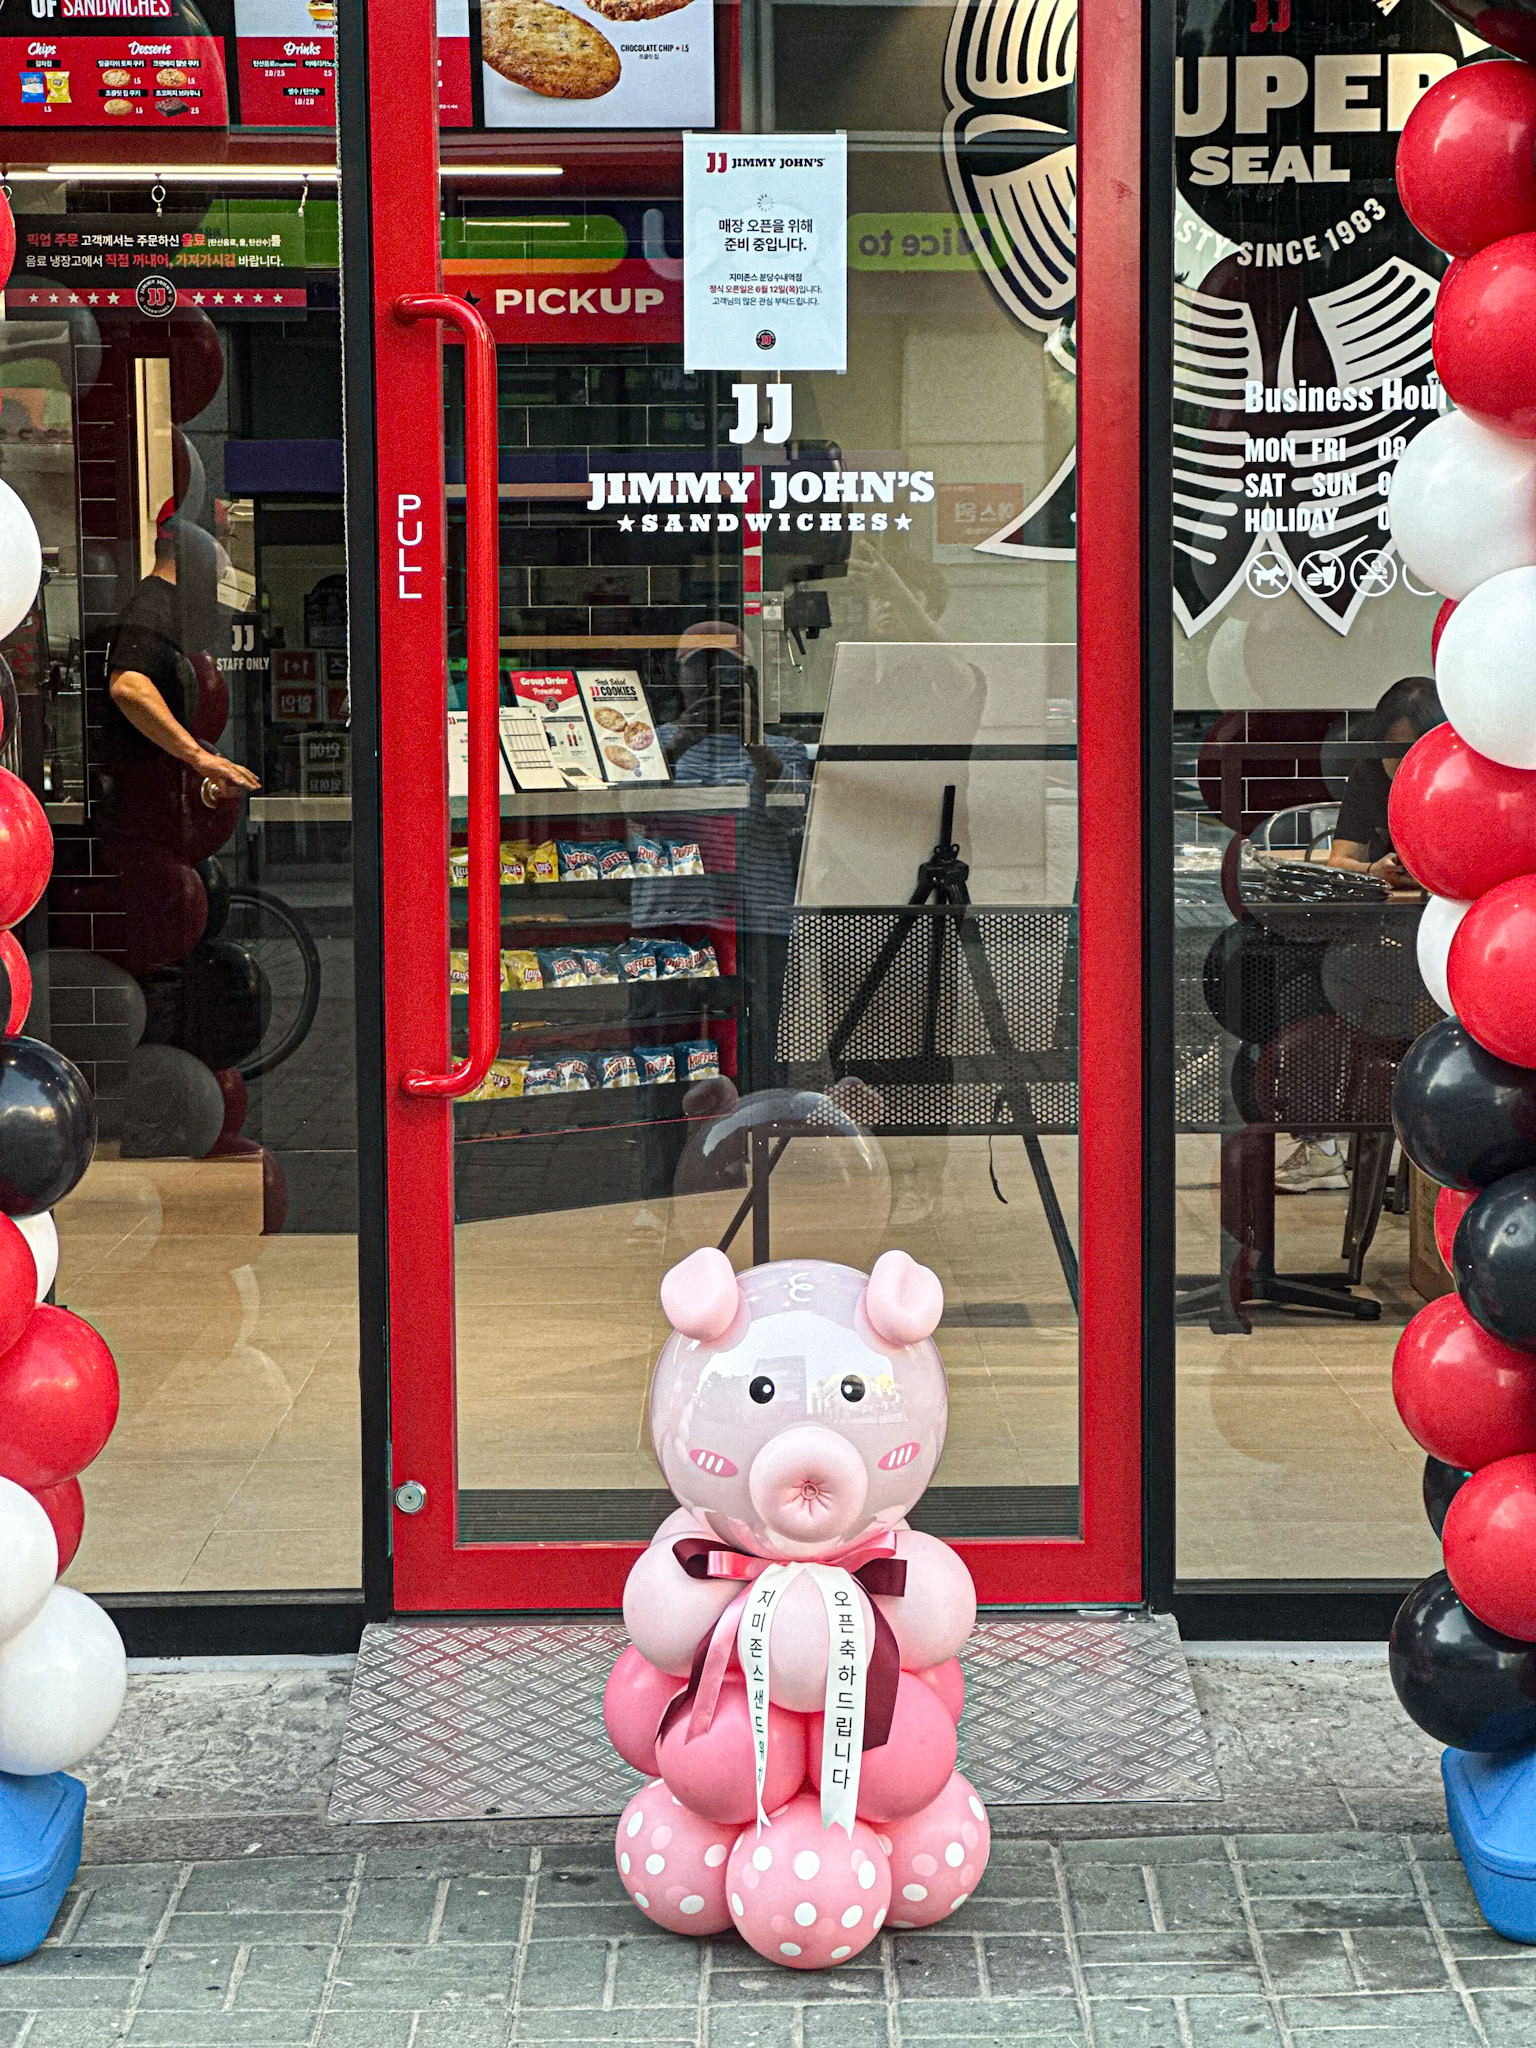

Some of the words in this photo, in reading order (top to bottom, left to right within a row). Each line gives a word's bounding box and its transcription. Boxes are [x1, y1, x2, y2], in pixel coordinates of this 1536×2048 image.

[28, 42, 57, 58] Chips
[128, 41, 172, 55] Desserts
[283, 41, 321, 56] Drinks
[621, 44, 657, 52] CHOCOLATE
[658, 44, 674, 52] CHIP
[706, 152, 727, 173] JJ
[732, 158, 776, 169] JIMMY
[779, 158, 824, 169] JOHN'S
[1189, 145, 1350, 185] SEAL
[719, 218, 745, 233] 매장
[747, 218, 785, 233] 오픈을
[788, 218, 813, 233] 위해
[1175, 211, 1231, 260] STY
[1236, 235, 1321, 267] SINCE
[1324, 198, 1386, 251] 1983
[81, 235, 134, 247] 고객께서는
[136, 235, 179, 247] 주문하신
[182, 233, 205, 248] 음료
[725, 237, 749, 252] 준비
[752, 237, 807, 252] 중입니다.
[25, 255, 47, 267] 음료
[50, 255, 103, 267] 냉장고에서
[105, 253, 129, 267] 직접
[175, 253, 236, 268] 가져가시길
[238, 254, 284, 268] 바랍니다.
[495, 288, 665, 315] PICKUP
[1244, 379, 1374, 413] Business
[729, 383, 792, 444] JJ
[1245, 437, 1296, 462] MON
[1312, 437, 1346, 461] FRI
[586, 472, 755, 510] JIMMY
[769, 470, 935, 510] JOHN'S
[1245, 473, 1286, 497] SAT
[1312, 472, 1357, 496] SUN
[641, 513, 888, 532] SANDWICHES
[1245, 507, 1339, 532] HOLIDAY
[397, 493, 422, 599] PULL
[231, 624, 255, 652] JJ
[216, 657, 244, 671] STAFF
[246, 657, 270, 671] ONLY
[520, 677, 544, 686] Group
[544, 677, 568, 685] Order
[600, 686, 637, 696] COOKIES
